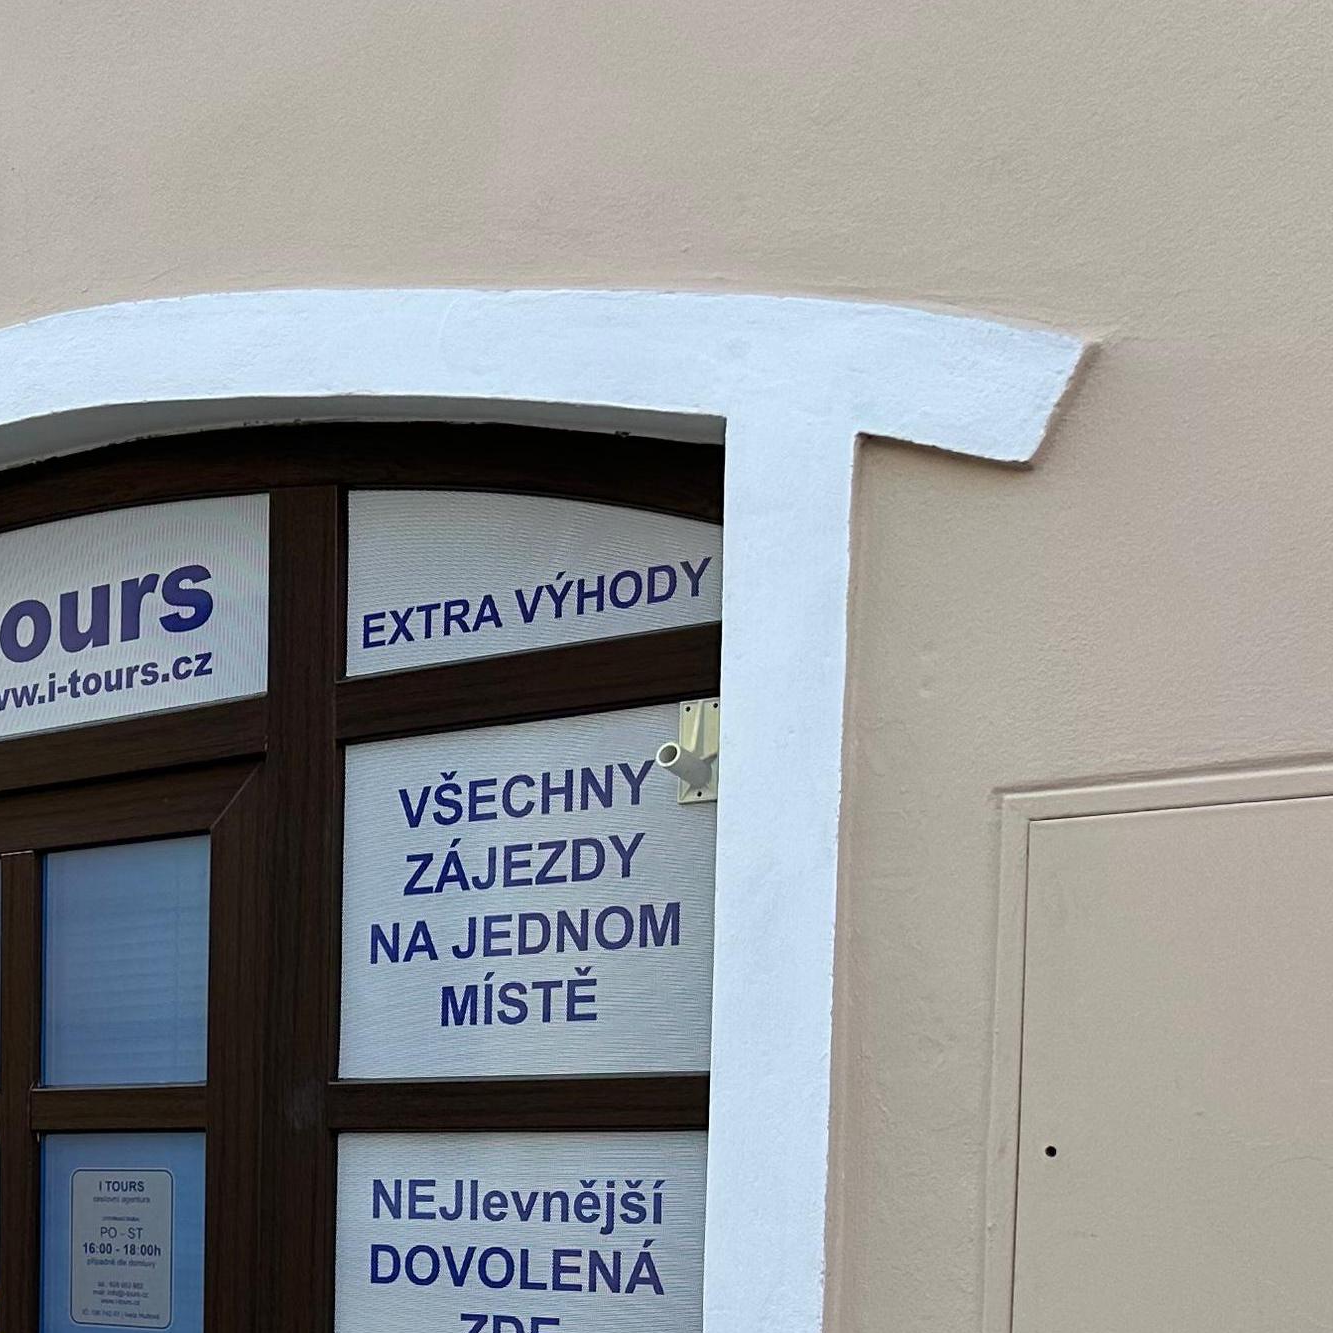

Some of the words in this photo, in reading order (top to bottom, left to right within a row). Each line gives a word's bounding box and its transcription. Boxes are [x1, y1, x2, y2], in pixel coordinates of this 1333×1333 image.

[362, 594, 503, 649] EXTRA
[514, 556, 713, 624] VÝHODY
[398, 759, 656, 829] VŠECHNY
[403, 832, 646, 896] ZÁJEZDY
[369, 919, 438, 964] NA
[451, 901, 681, 960] JEDNOM
[440, 966, 599, 1027] MÍSTĚ
[105, 1180, 145, 1192] TOURS
[372, 1179, 665, 1236] NEJlevnější
[82, 1242, 112, 1254] 16:00
[124, 1243, 161, 1256] 18:00h
[100, 1226, 118, 1239] PO
[127, 1227, 143, 1240] ST
[370, 1239, 665, 1296] DOVOLENÁ
